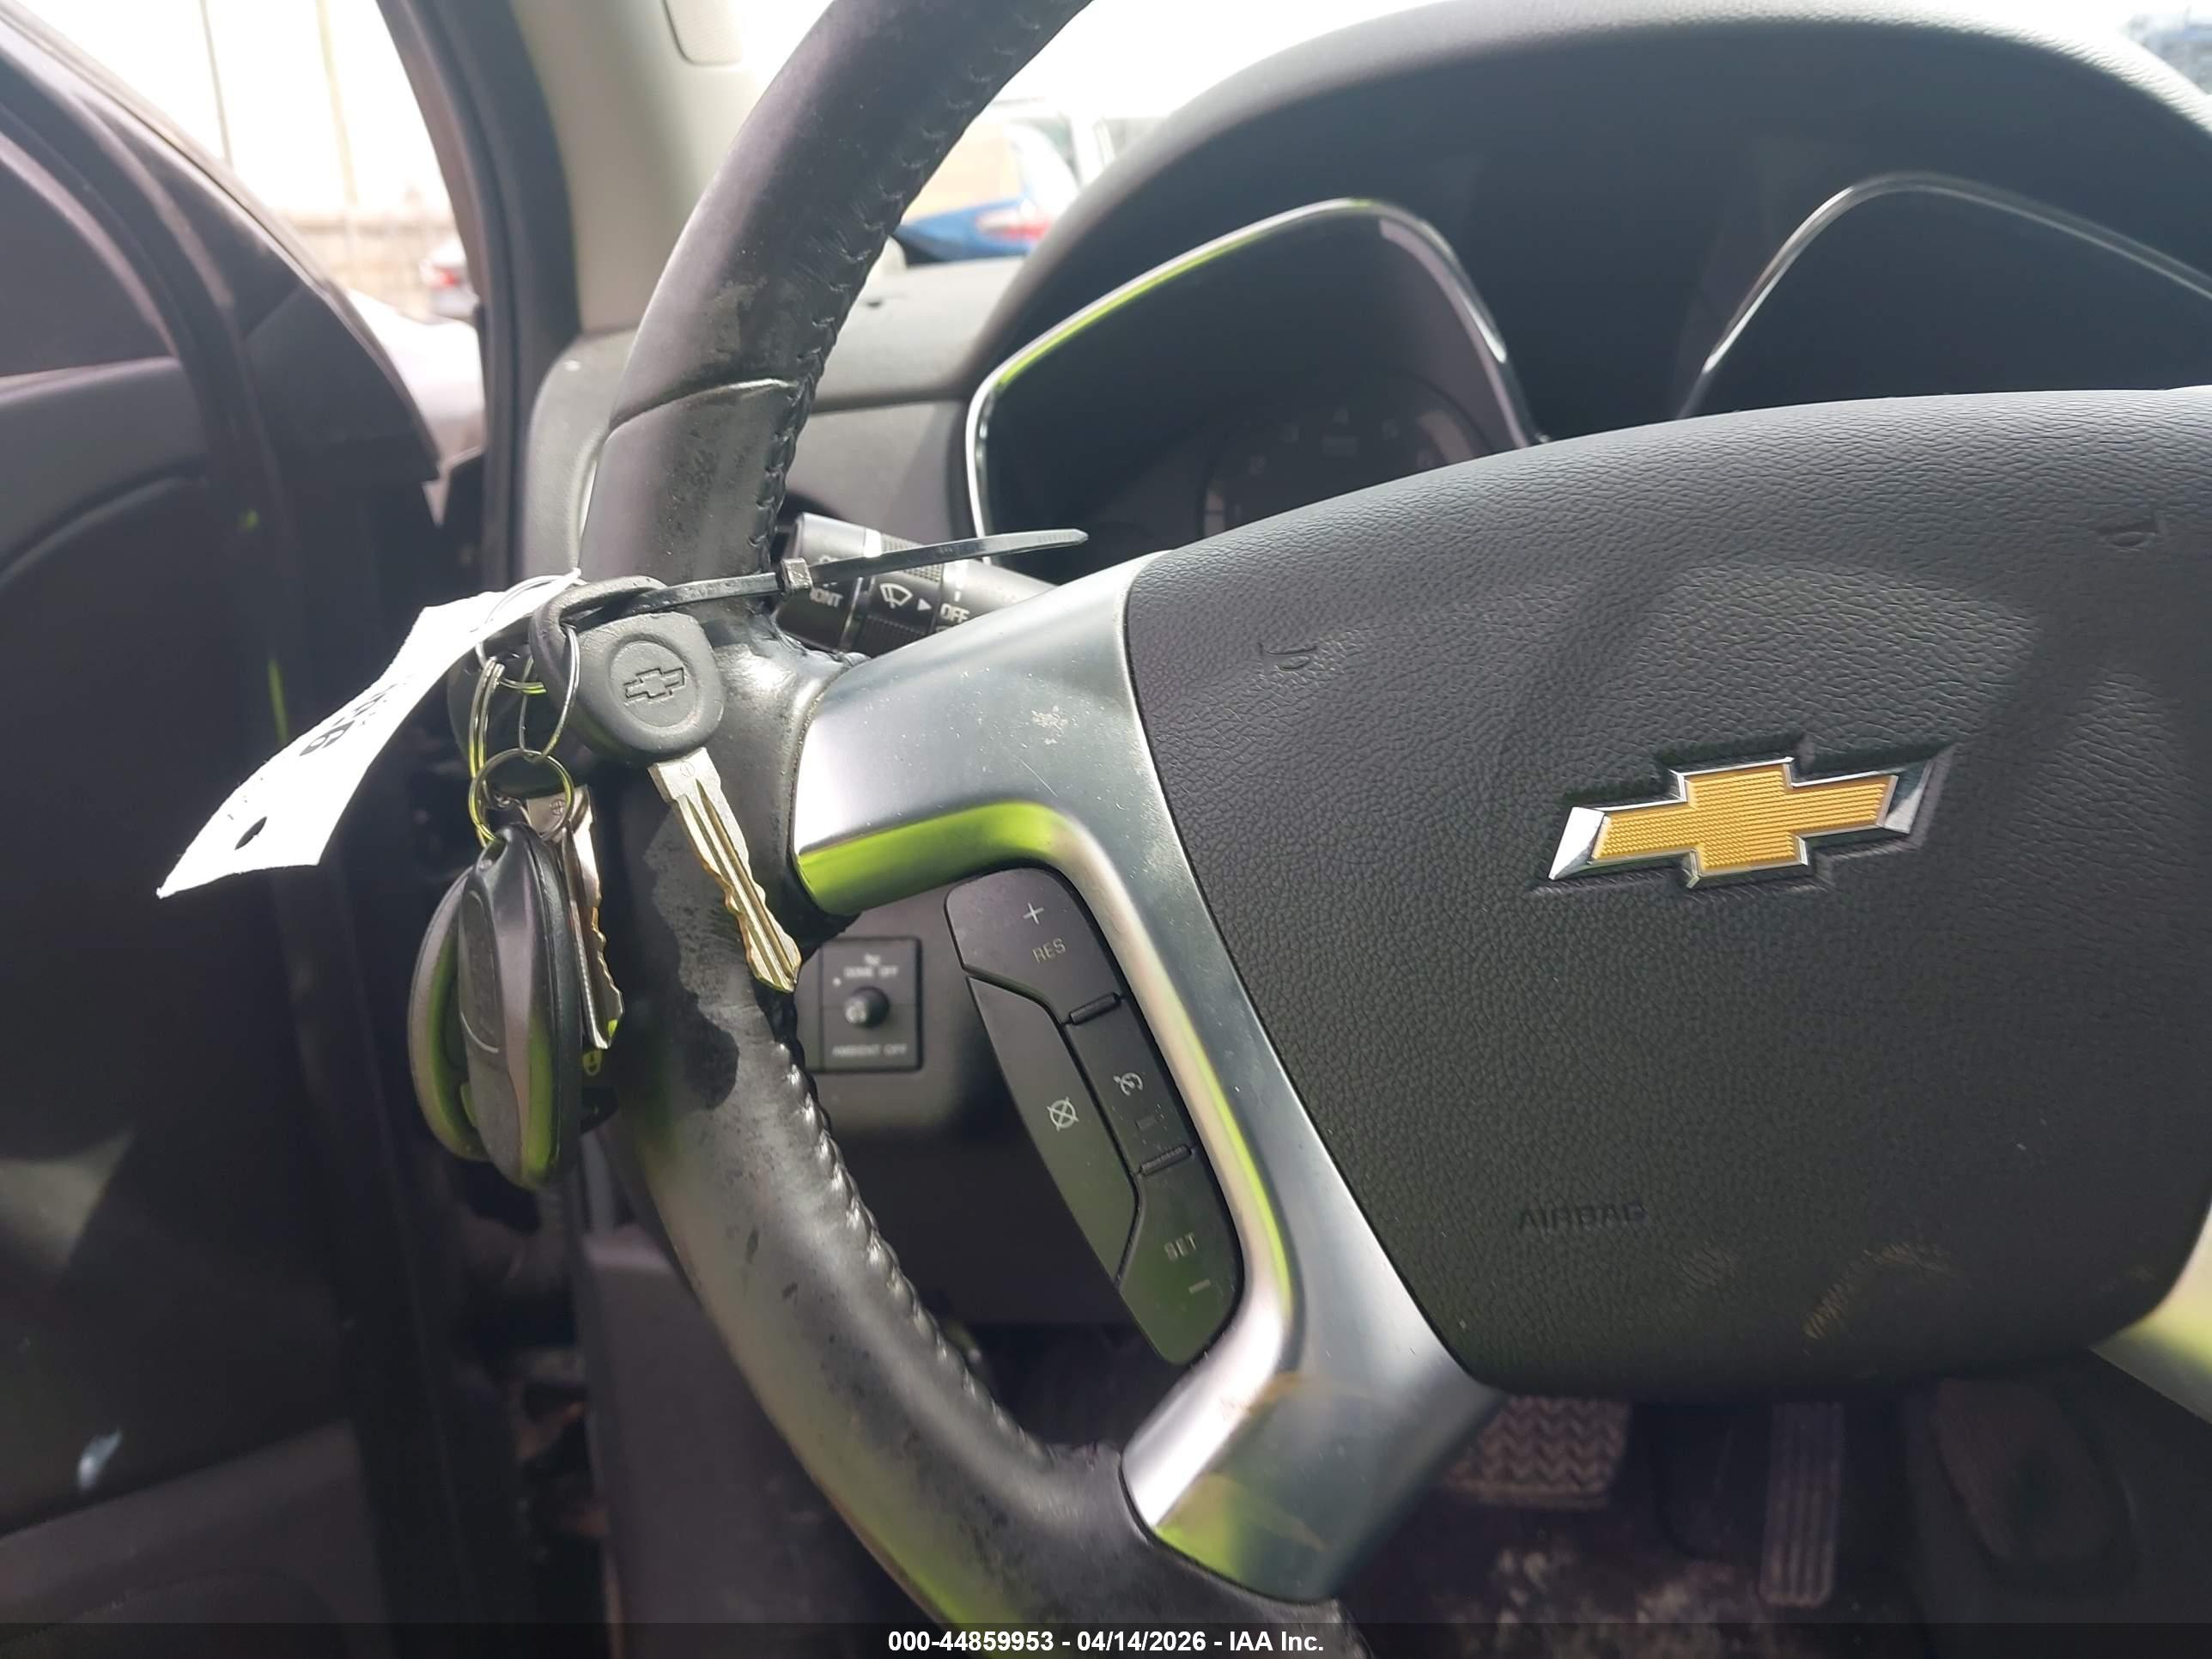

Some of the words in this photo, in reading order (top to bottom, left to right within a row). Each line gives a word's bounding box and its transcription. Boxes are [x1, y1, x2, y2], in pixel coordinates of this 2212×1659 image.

[940, 603, 970, 623] OFF
[1032, 937, 1066, 963] RES
[1517, 1200, 1648, 1231] AIRBAG
[1164, 1231, 1197, 1261] SET
